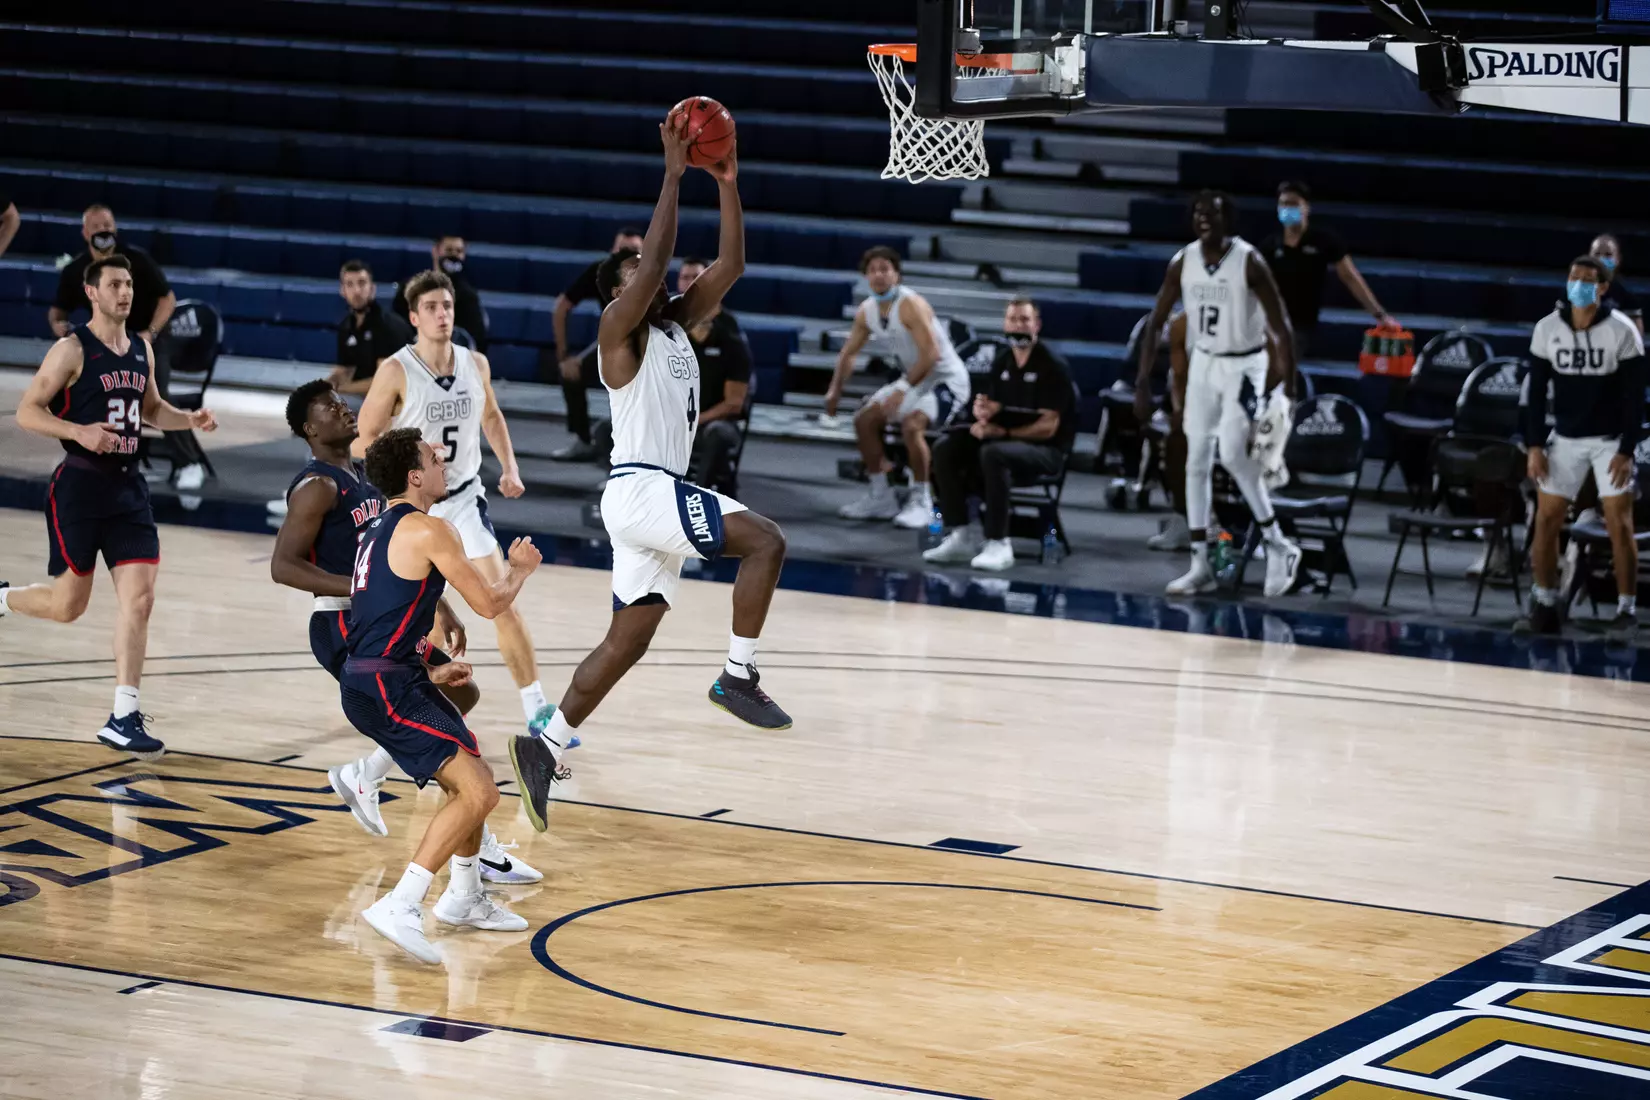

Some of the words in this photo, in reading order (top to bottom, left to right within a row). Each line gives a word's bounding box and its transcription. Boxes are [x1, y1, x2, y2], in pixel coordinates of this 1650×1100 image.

[1468, 47, 1619, 83] SPALDING
[1199, 305, 1219, 336] 12
[667, 355, 700, 380] CBU
[1557, 348, 1604, 369] CBU
[100, 370, 146, 393] DIXIE
[107, 398, 140, 431] 24
[426, 397, 471, 423] CBU
[686, 386, 697, 432] 4
[442, 426, 459, 463] 5
[685, 493, 714, 543] LANCERS
